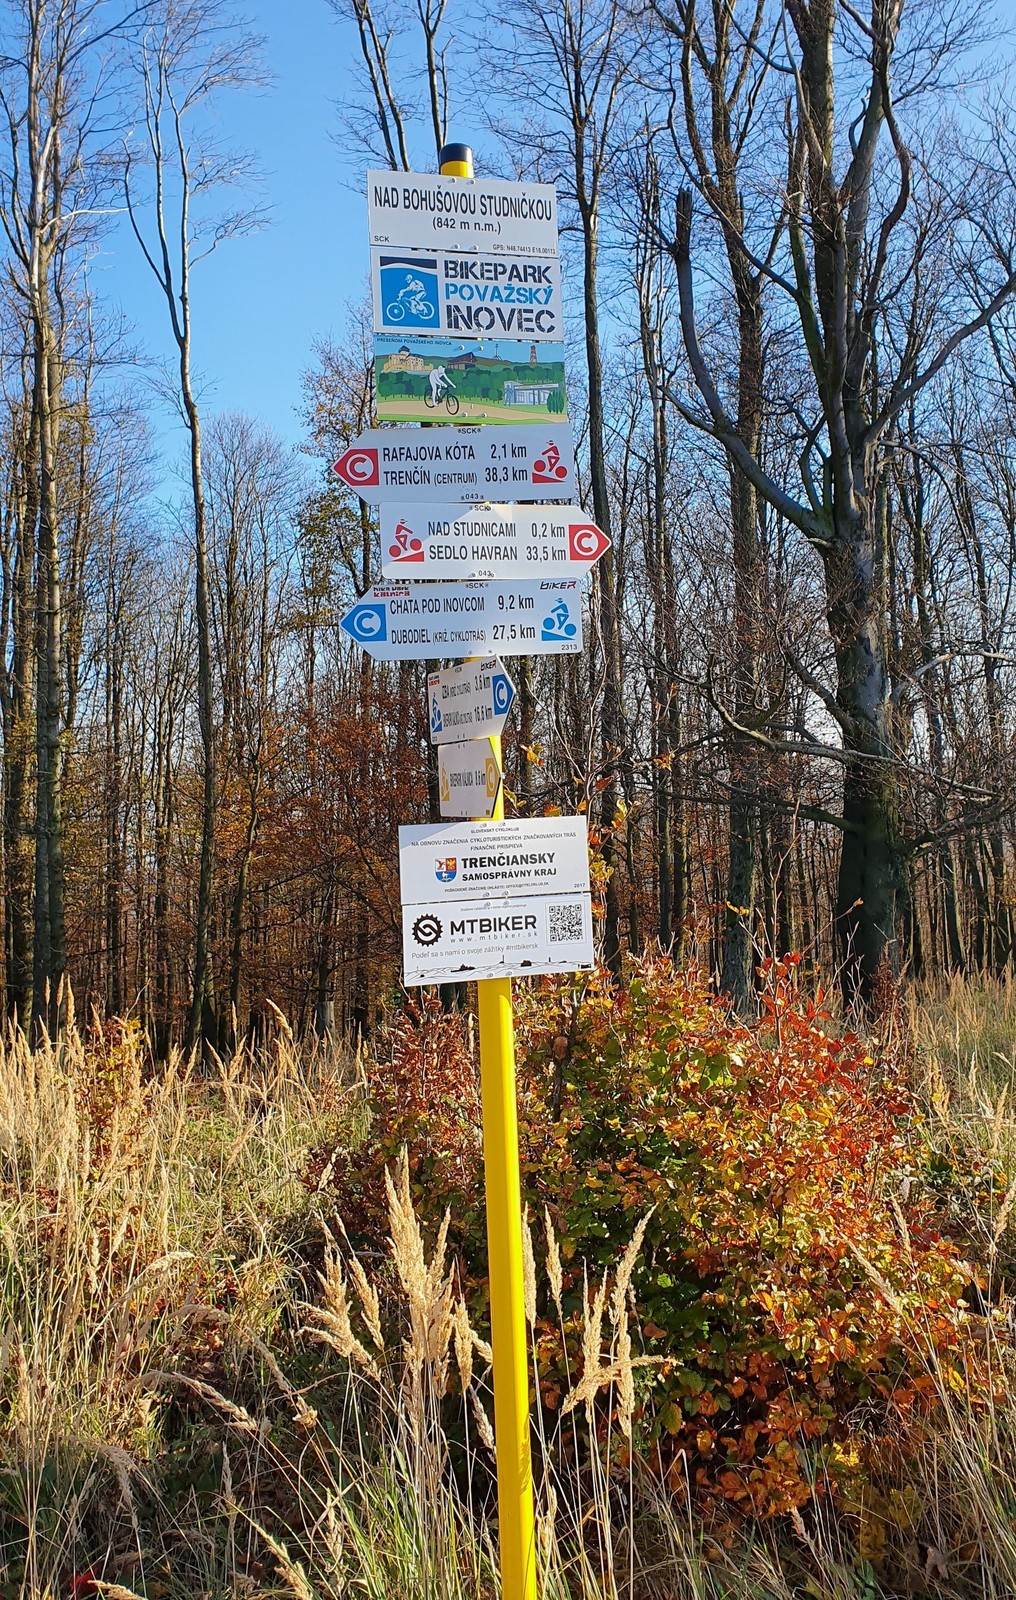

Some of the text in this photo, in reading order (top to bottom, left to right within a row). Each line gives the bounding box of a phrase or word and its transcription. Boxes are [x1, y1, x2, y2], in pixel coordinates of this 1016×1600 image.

[374, 185, 552, 221] NAD BOHUŠOVOU STUDNIČKOU
[433, 217, 501, 235] (842 m n.m.)
[374, 235, 390, 243] SCK
[444, 260, 552, 284] BIKEPARK
[445, 283, 553, 305] POVAŽSKÝ
[446, 305, 555, 333] INOVEC
[383, 441, 527, 462] RAFAJOVA KÓTA 2,1 km
[383, 466, 528, 487] TRENČÍN (CENTRUM) 38,3 km
[428, 521, 565, 539] NAD STUDNICAMI 0,2 km
[429, 545, 566, 563] SEDLO HAVRAN 33,5 km
[390, 595, 534, 614] CHATA POD INOVCOM 9,2 km
[392, 629, 430, 644] DUBODIEL
[451, 629, 486, 643] CYKLOTRÁS)
[493, 625, 517, 642] 27,5
[520, 623, 536, 638] km
[470, 835, 521, 843] CYKLOTURISTICKÝCH
[461, 852, 556, 868] TRENČIANSKY
[462, 867, 556, 881] SAMOSPRÁVNY KRAJ
[450, 915, 537, 935] MTBIKER
[467, 947, 483, 955] svoje
[506, 943, 538, 951] #mtbikersk
